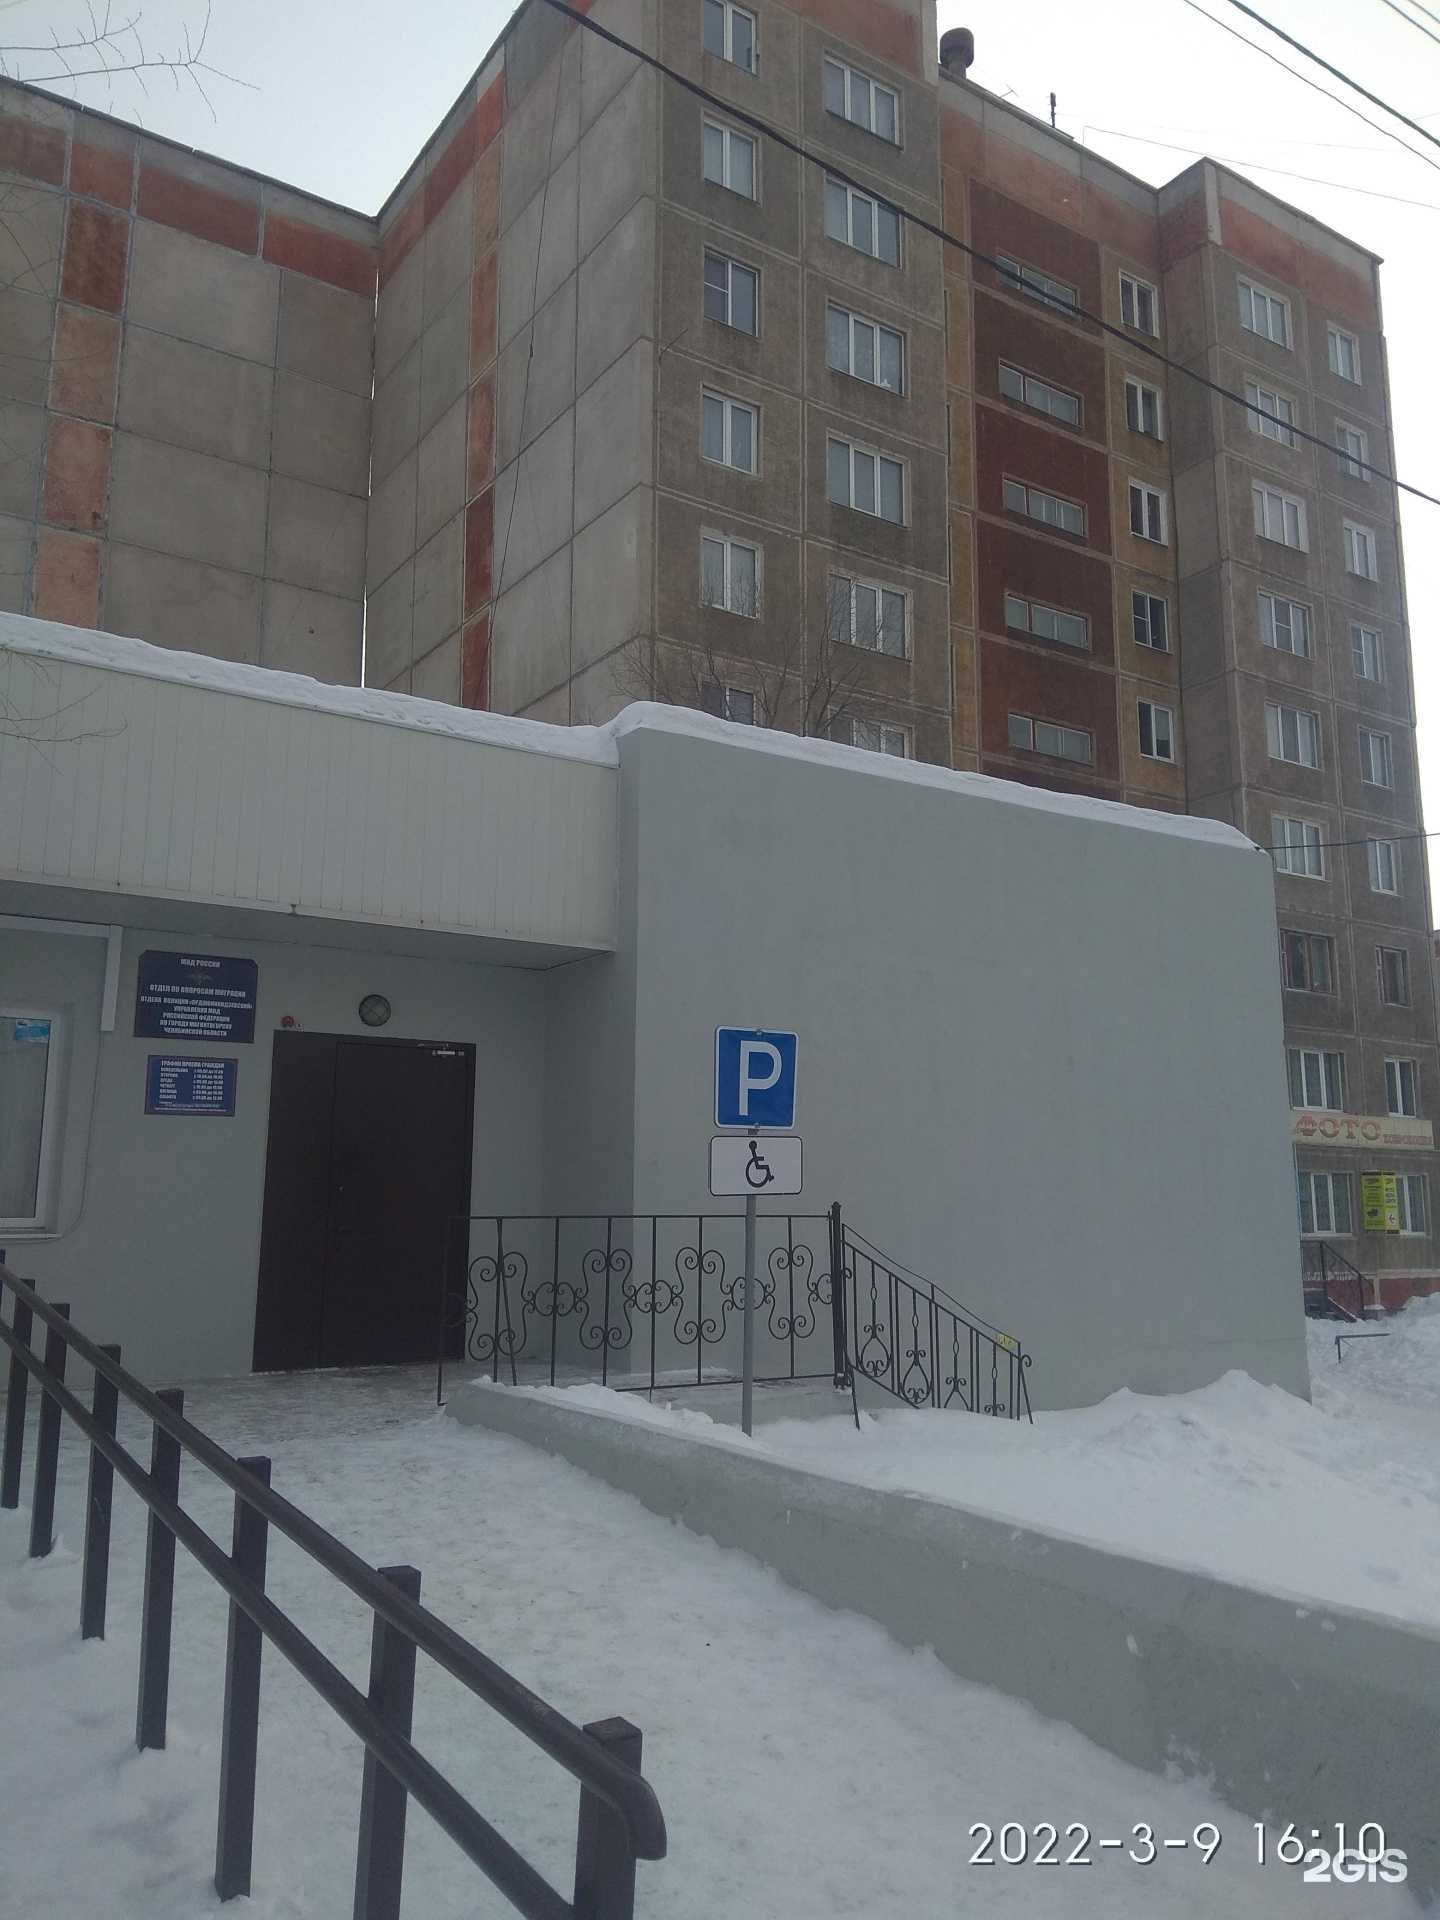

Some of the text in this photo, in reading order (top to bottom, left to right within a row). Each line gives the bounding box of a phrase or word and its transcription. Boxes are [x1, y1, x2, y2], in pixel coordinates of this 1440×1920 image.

[196, 960, 221, 968] РОССИИ
[150, 984, 246, 998] ОТДЕЛ ПО ВОПРОСАМ МИГРАЦИИ
[1296, 1116, 1382, 1141] ФОТО
